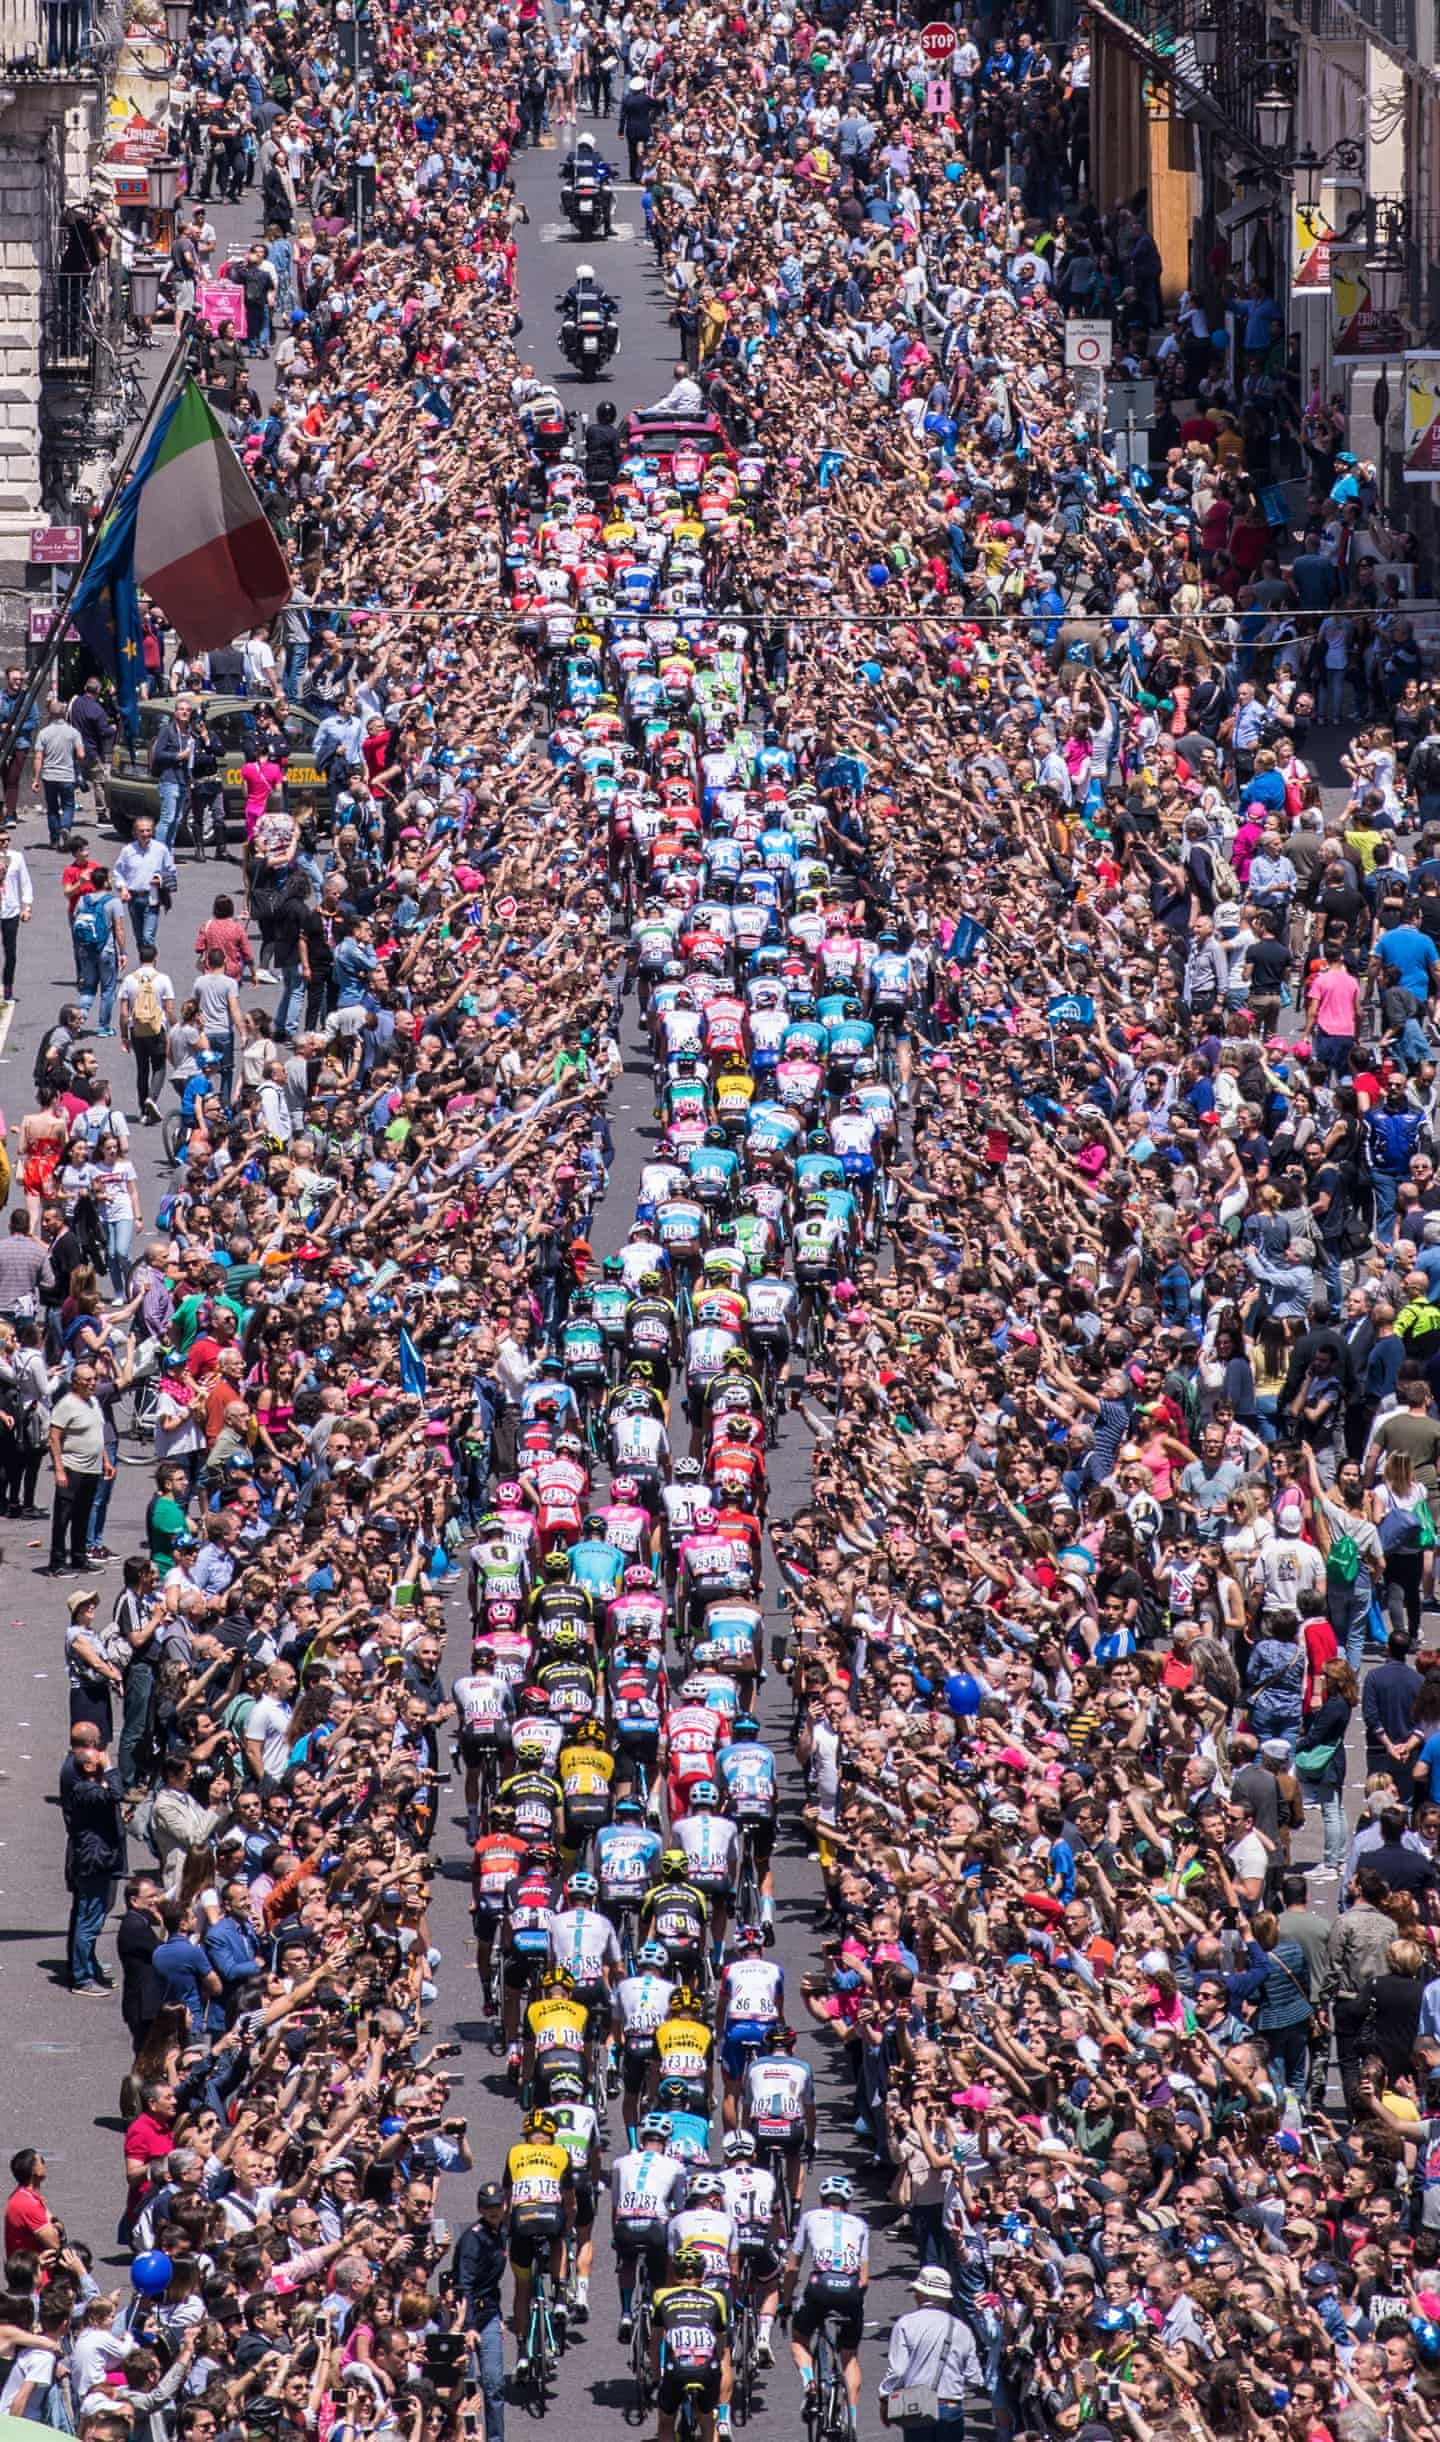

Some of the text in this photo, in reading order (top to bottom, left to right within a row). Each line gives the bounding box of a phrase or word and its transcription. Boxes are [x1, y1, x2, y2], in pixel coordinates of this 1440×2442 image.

[923, 33, 954, 50] STOP
[736, 1998, 750, 2011] 86
[540, 2179, 560, 2195] 175
[639, 2192, 658, 2210] 187
[734, 2201, 768, 2215] 6 6
[673, 2328, 714, 2348] 113 113
